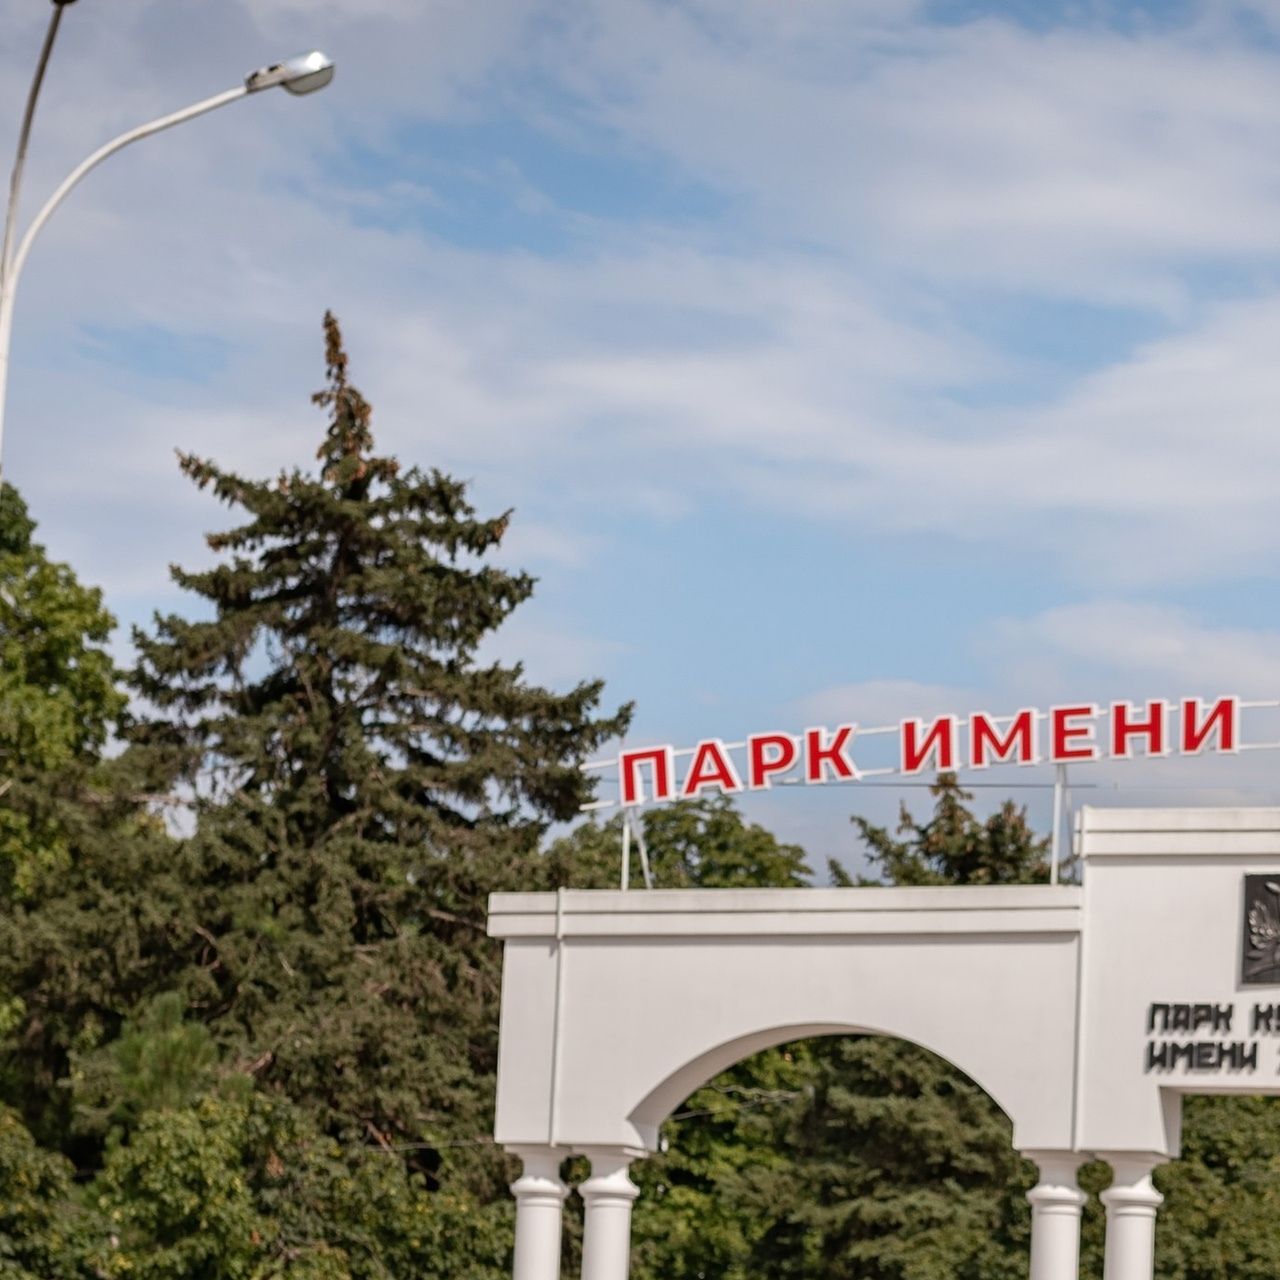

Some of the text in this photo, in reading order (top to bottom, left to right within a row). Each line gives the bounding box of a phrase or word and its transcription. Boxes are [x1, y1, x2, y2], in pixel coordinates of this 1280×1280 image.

[619, 725, 854, 802] ПАРК
[901, 696, 1236, 773] ИМЕНИ
[1148, 1003, 1234, 1034] ПАРК
[1146, 1041, 1258, 1072] ИМЕНИ
